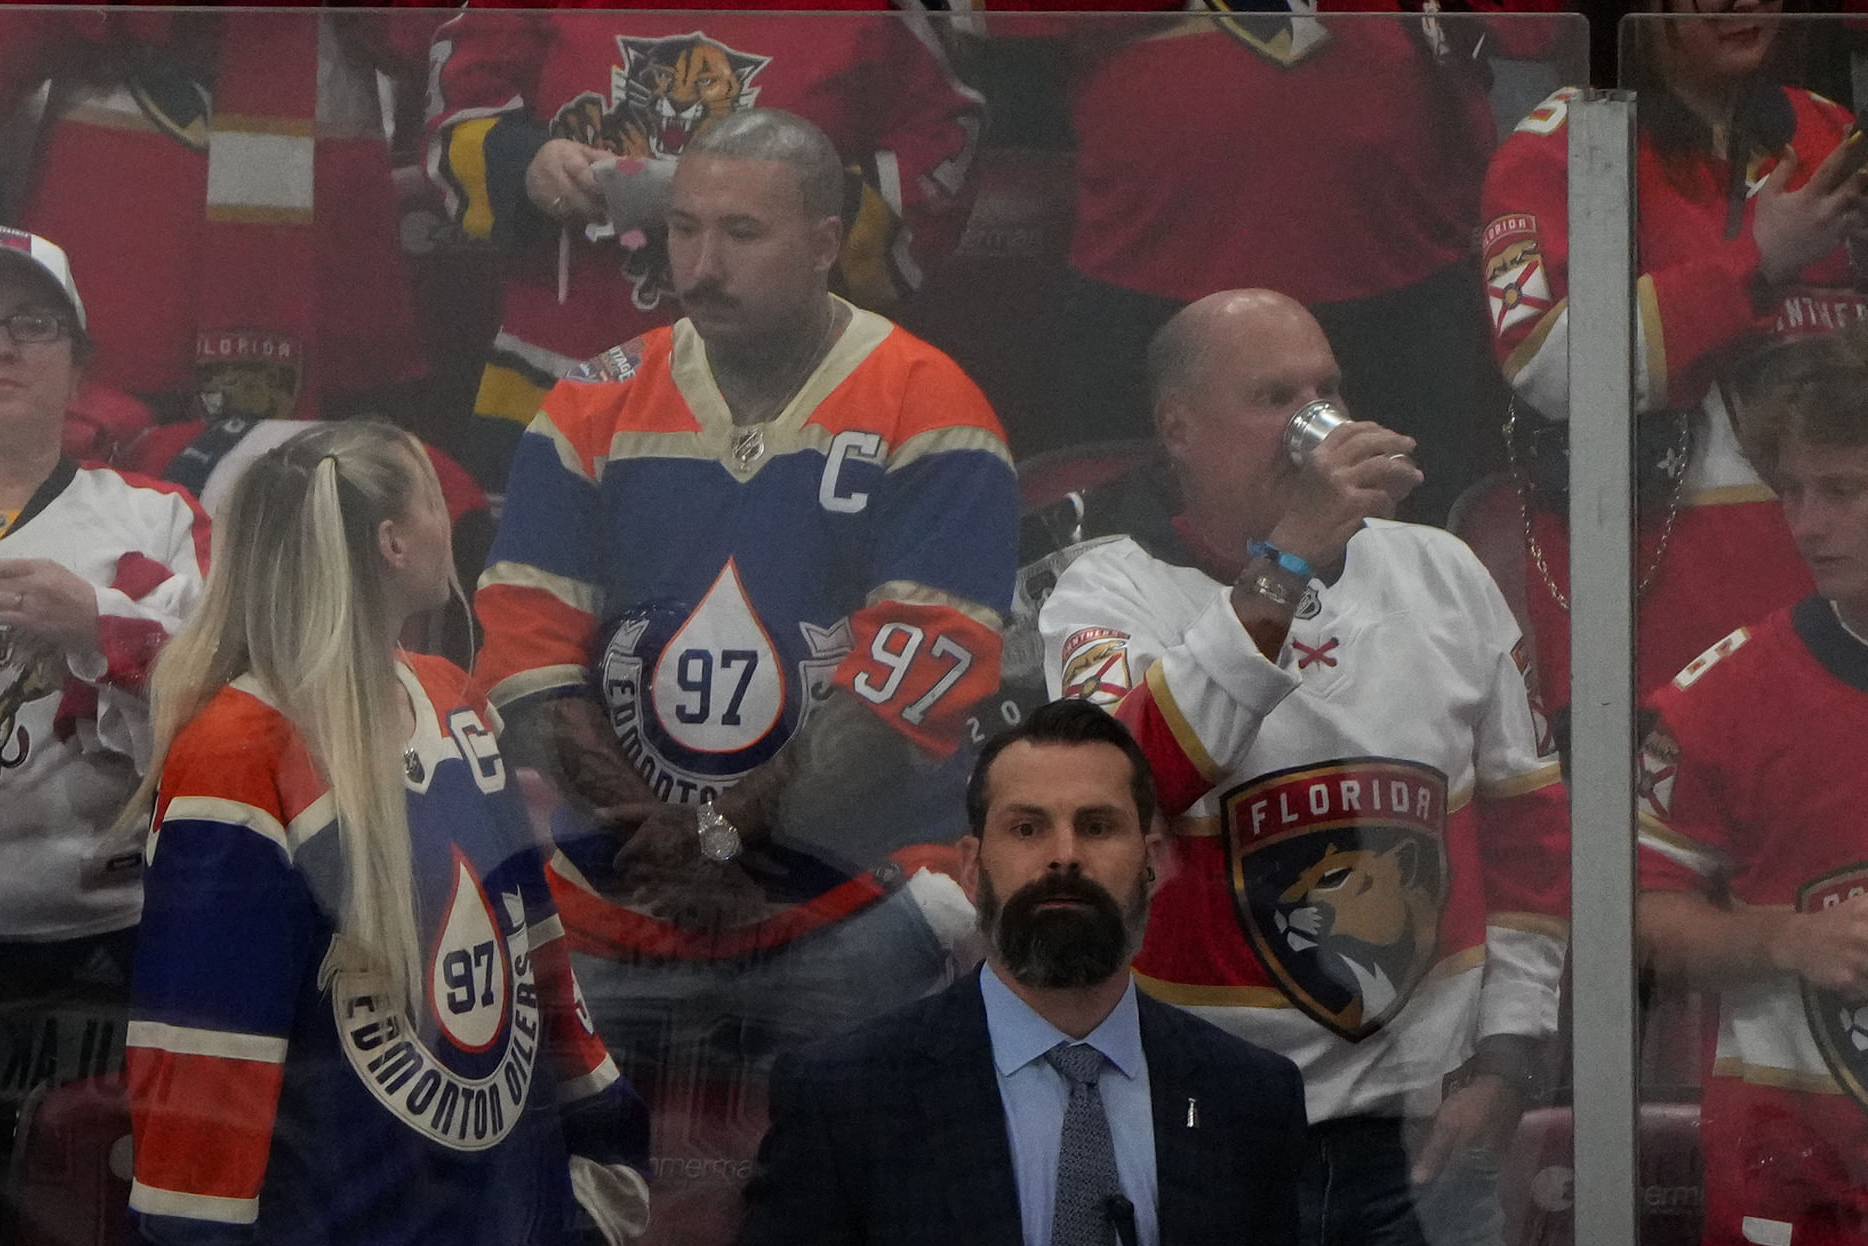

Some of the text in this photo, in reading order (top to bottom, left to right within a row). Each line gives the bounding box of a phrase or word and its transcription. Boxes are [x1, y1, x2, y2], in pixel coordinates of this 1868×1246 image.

[819, 432, 884, 513] C
[676, 648, 759, 726] 97
[853, 622, 973, 725] 97
[1251, 779, 1431, 836] FLORIDA
[442, 940, 495, 1015] 97
[504, 949, 539, 1105] OILERS
